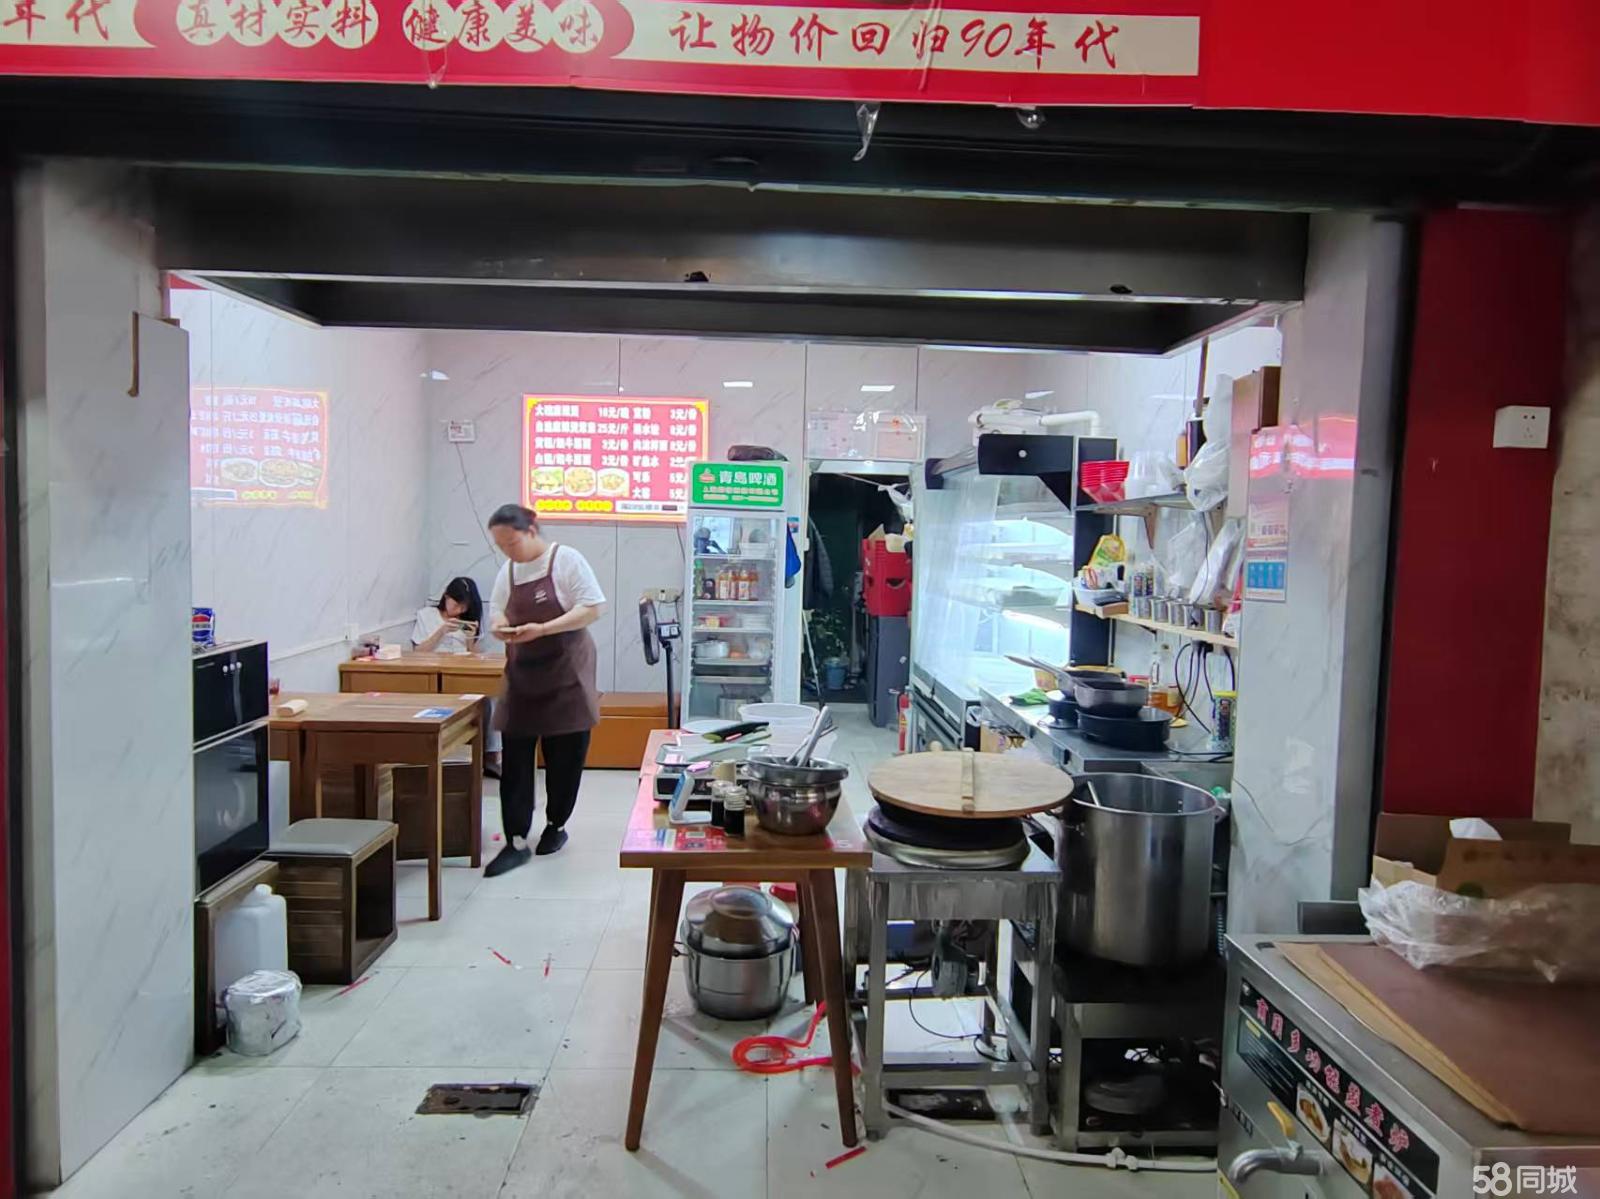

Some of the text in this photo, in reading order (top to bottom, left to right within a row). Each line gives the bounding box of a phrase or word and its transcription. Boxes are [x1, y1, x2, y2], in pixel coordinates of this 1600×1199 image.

[182, 0, 370, 45] 真材实料
[405, 2, 599, 47] 健康美味
[669, 12, 1119, 70] 让物价回归90年代
